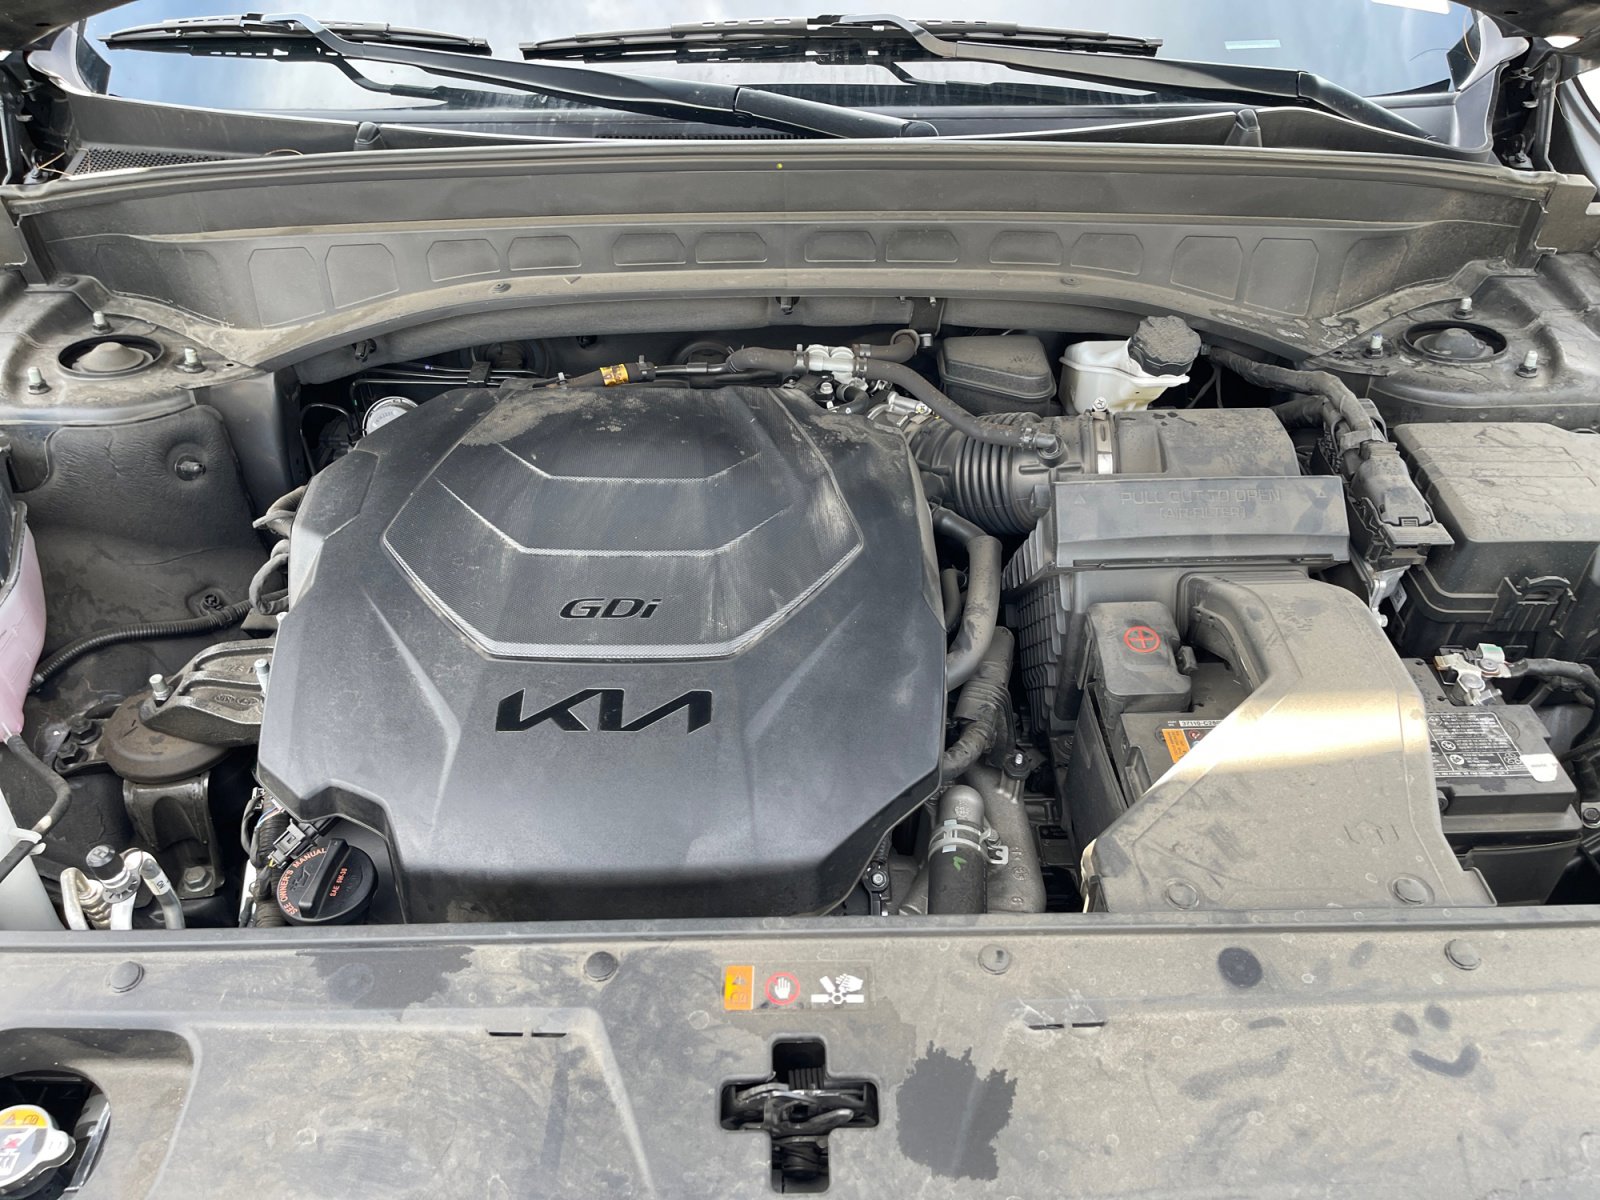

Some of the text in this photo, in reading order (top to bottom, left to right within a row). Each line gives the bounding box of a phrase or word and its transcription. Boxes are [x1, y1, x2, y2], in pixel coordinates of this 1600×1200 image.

[1120, 491, 1164, 504] PULL
[1235, 488, 1281, 502] OPEN
[560, 598, 661, 619] GDi
[495, 687, 713, 734] KIA
[280, 848, 326, 914] SEE OWNER'S MANUAL
